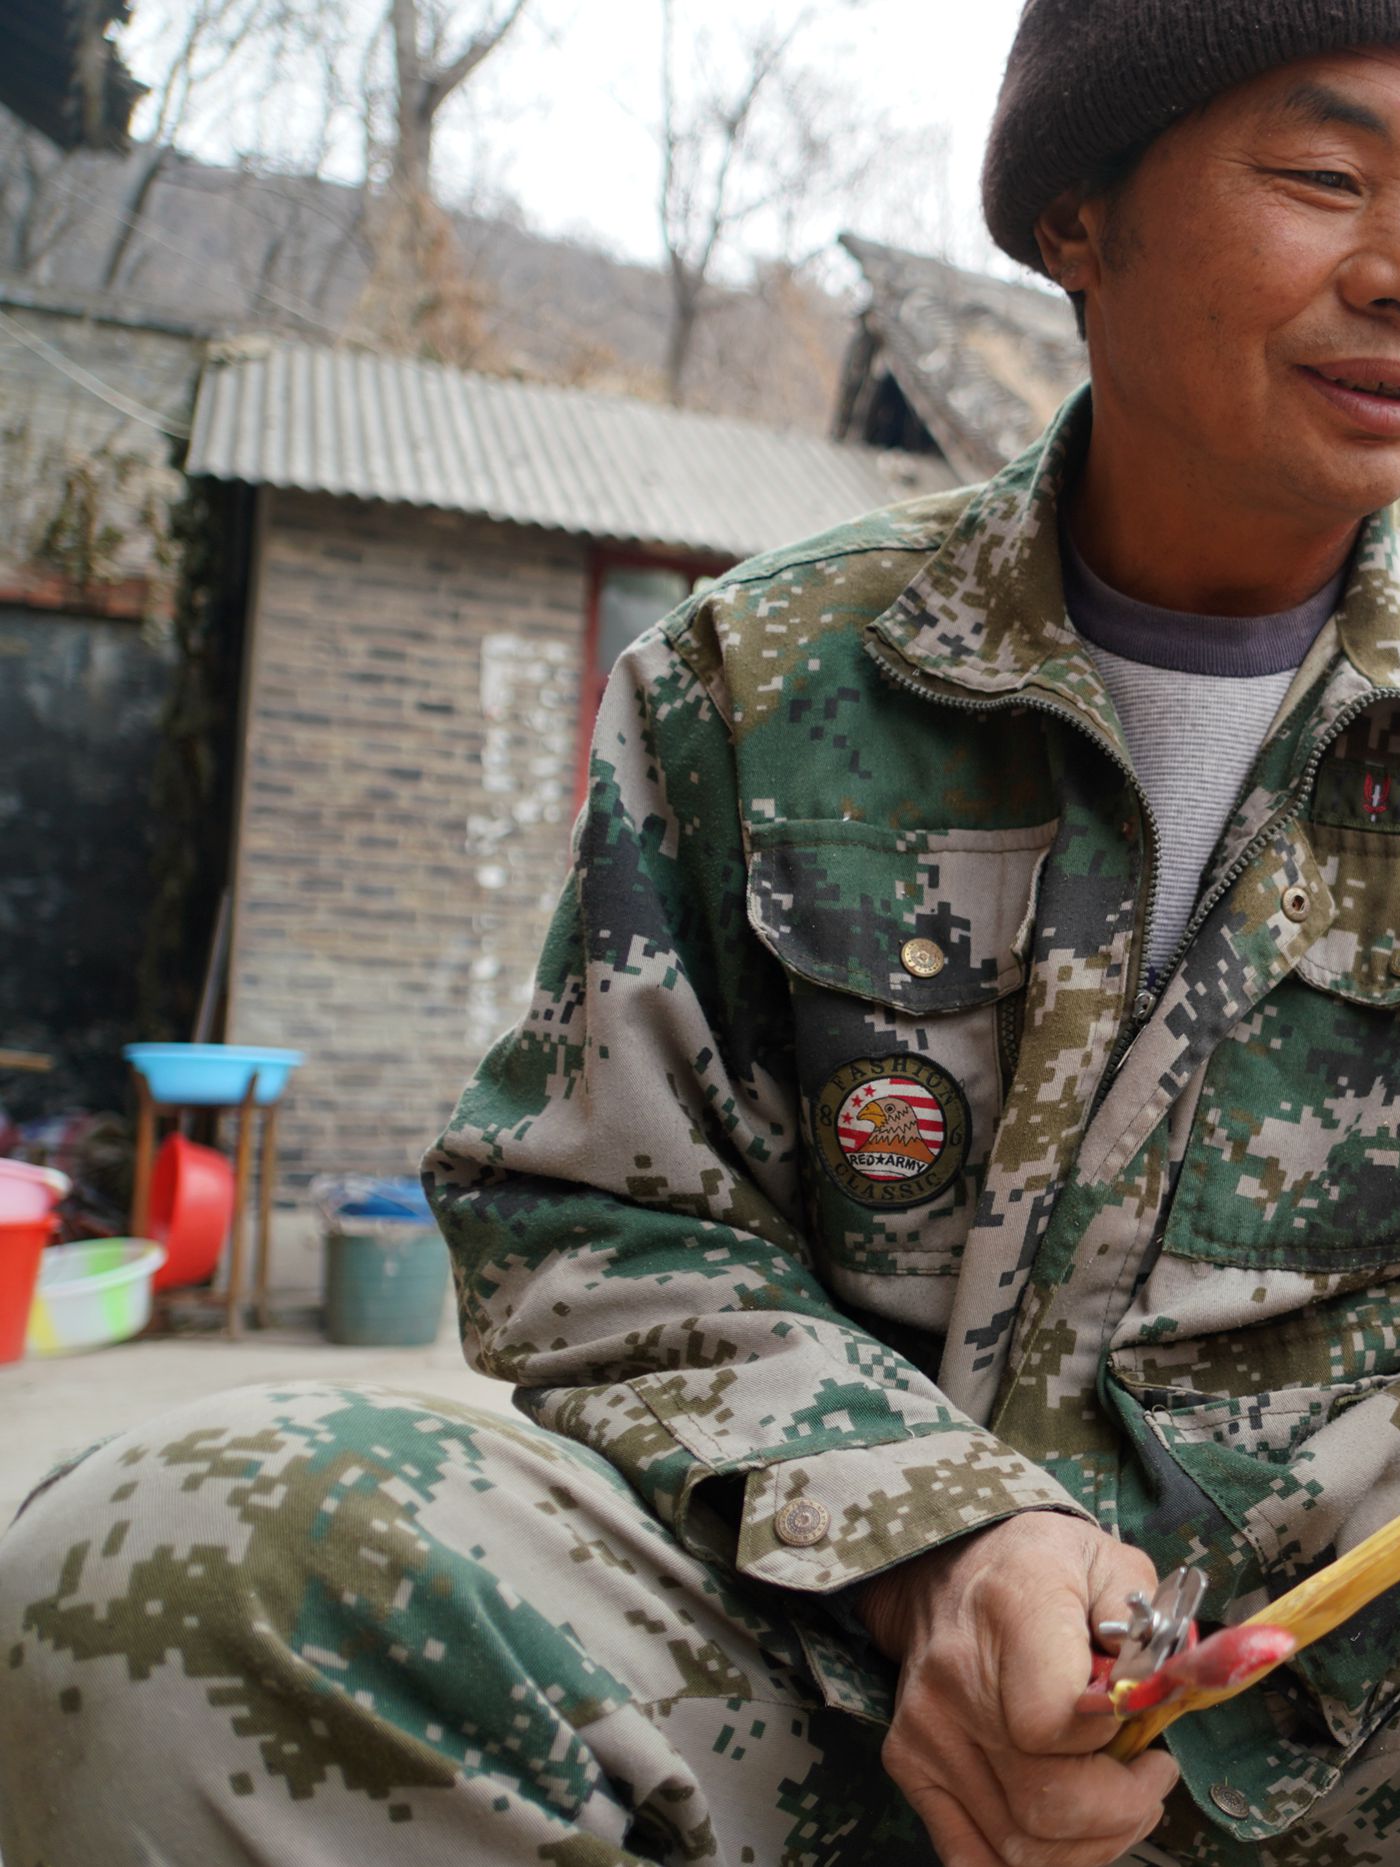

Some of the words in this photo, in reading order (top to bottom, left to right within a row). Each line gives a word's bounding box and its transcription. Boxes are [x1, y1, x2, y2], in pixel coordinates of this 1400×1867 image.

[831, 1057, 955, 1106] FASHION
[819, 1104, 832, 1127] 8
[951, 1124, 962, 1146] 6
[835, 1163, 942, 1199] CLASSIC
[850, 1154, 876, 1166] RED
[884, 1154, 927, 1173] ARMY
